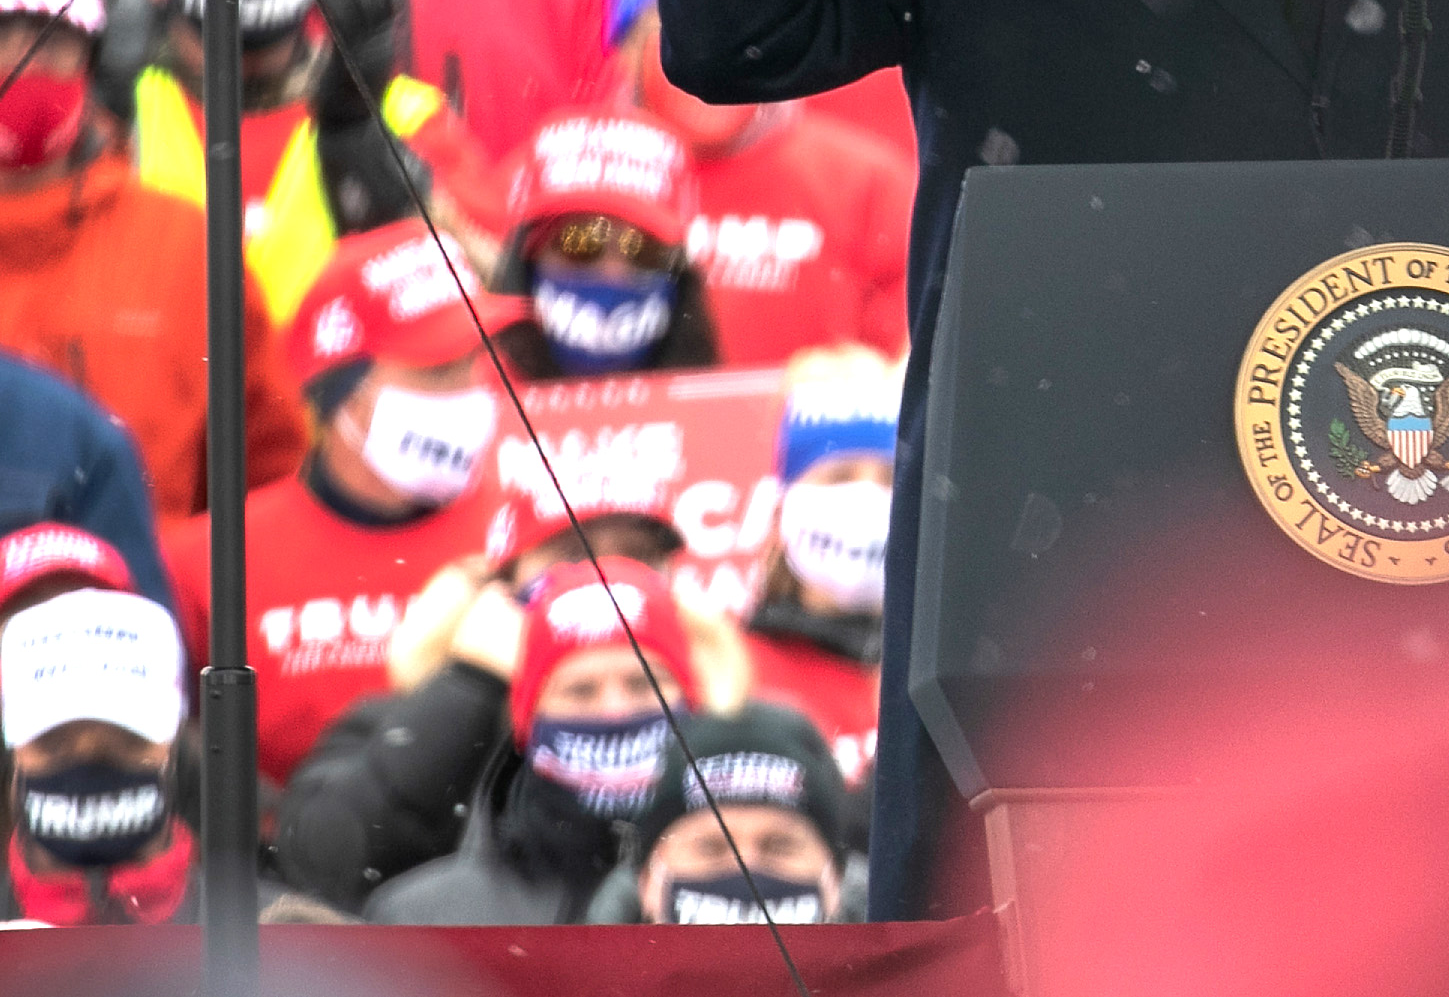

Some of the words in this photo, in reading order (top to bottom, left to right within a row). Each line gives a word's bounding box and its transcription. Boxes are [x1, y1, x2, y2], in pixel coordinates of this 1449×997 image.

[1407, 258, 1437, 279] OF
[1250, 256, 1396, 406] PRESIDENT
[1252, 420, 1278, 467] THE
[1268, 474, 1293, 502] OF
[1296, 499, 1381, 567] SEAL
[25, 787, 164, 841] TRUMP
